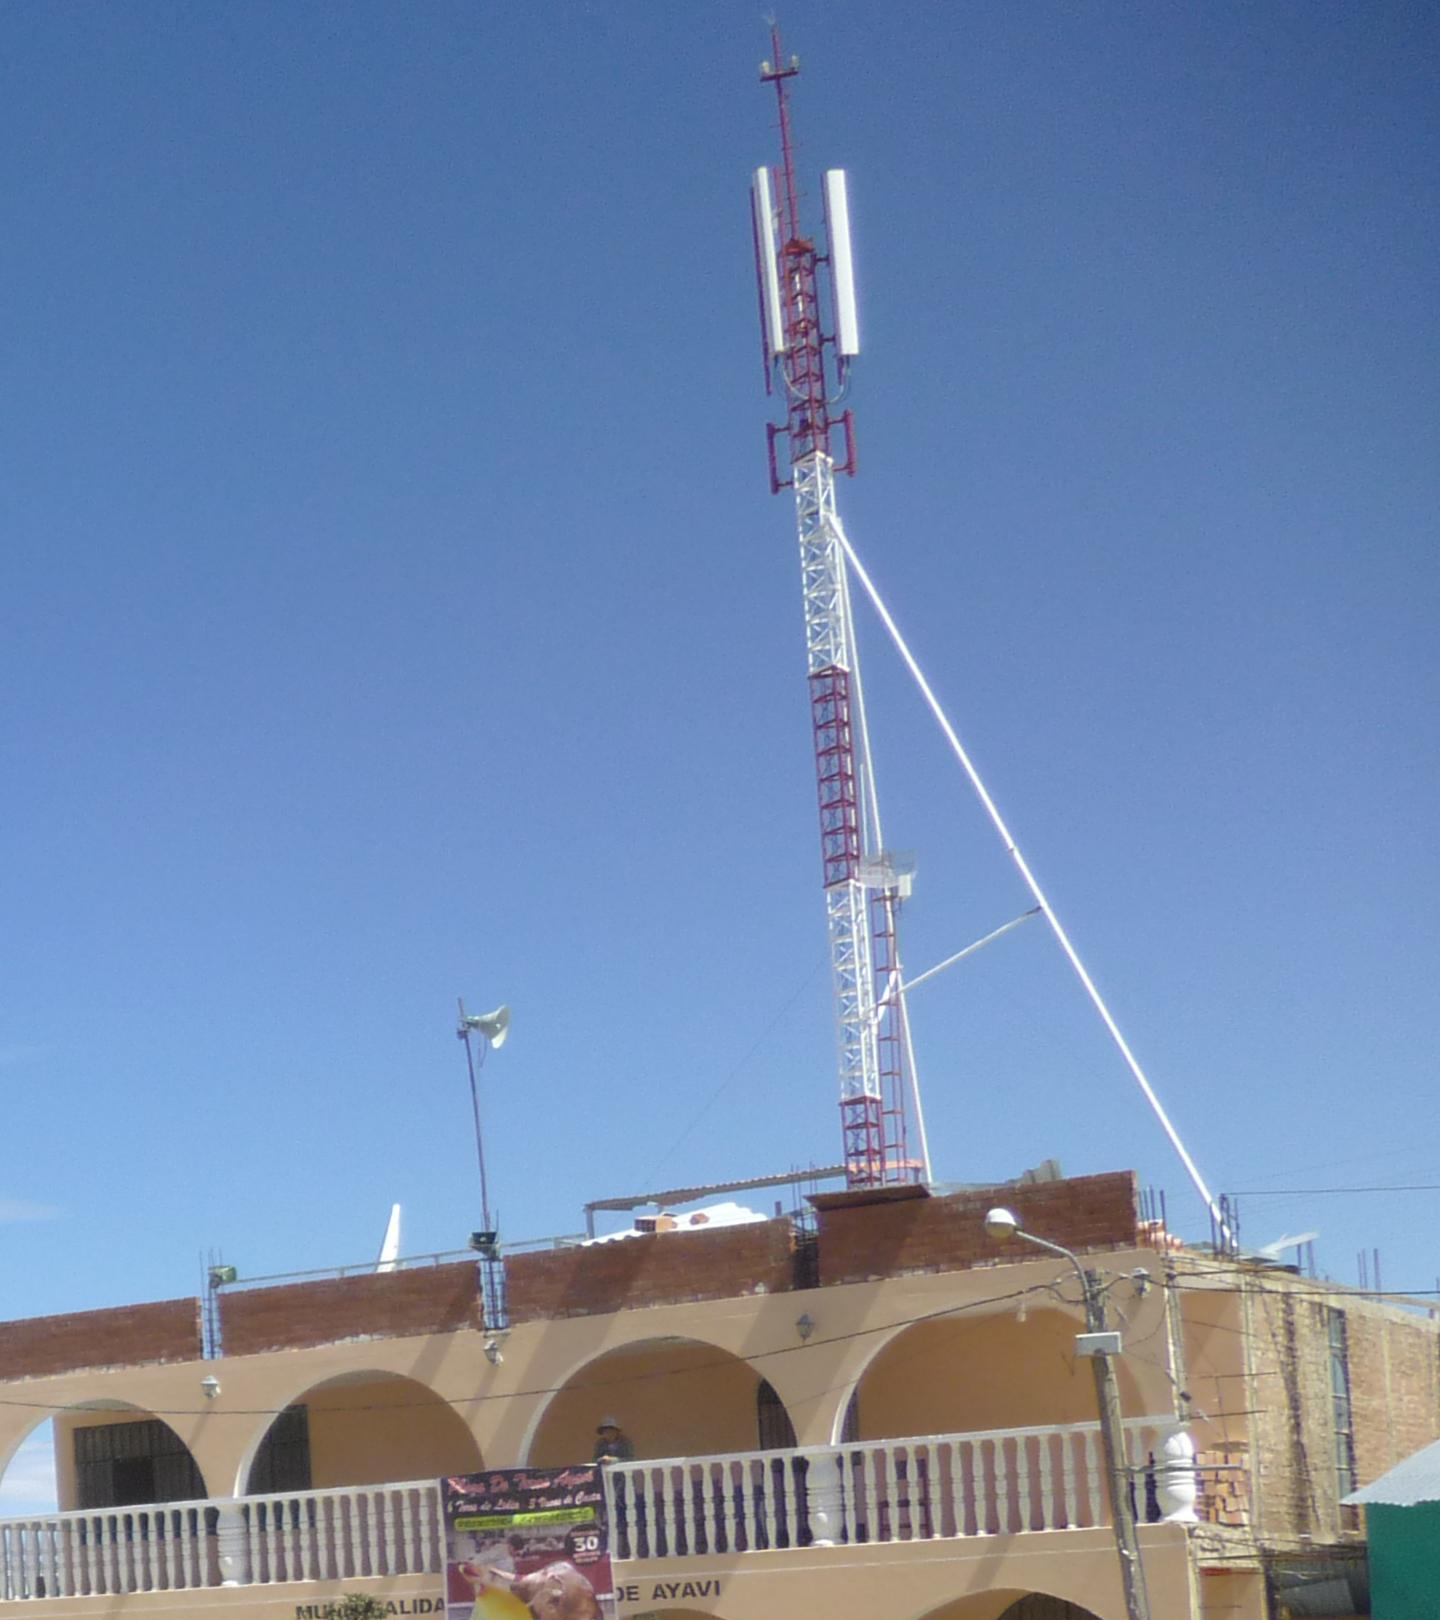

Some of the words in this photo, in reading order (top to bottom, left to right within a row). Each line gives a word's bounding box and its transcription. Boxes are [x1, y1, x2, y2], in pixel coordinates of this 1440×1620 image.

[573, 1535, 599, 1552] 30
[295, 1597, 445, 1620] MUALIDA
[652, 1579, 720, 1601] AYAVI
